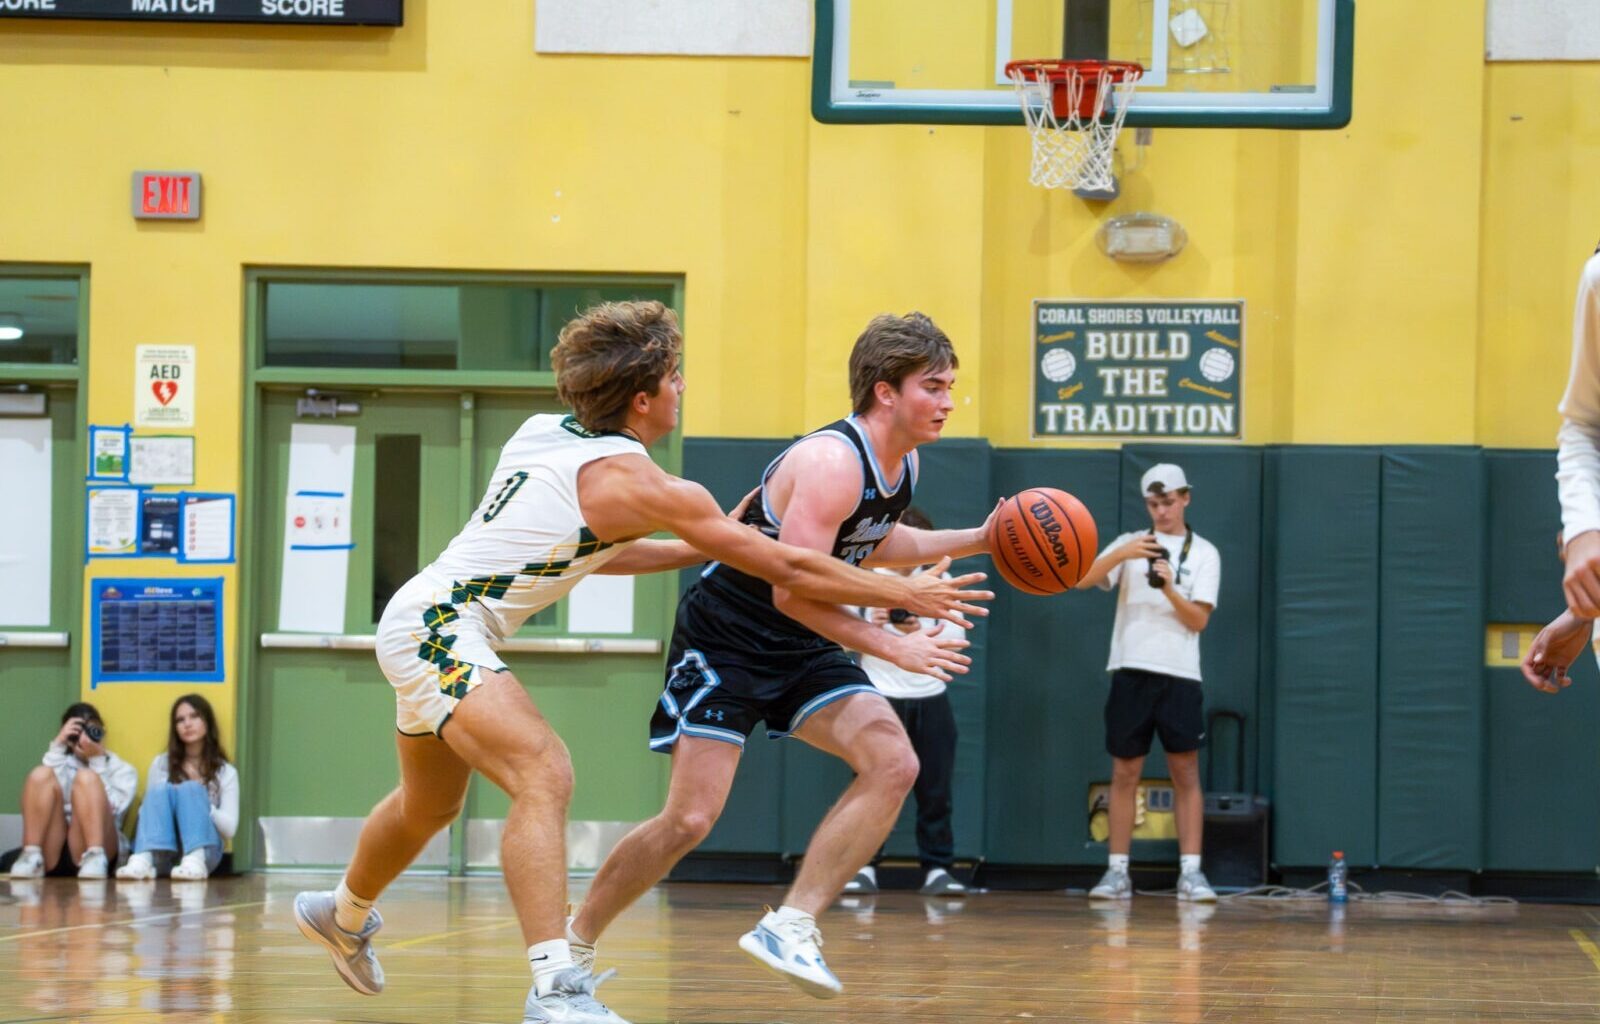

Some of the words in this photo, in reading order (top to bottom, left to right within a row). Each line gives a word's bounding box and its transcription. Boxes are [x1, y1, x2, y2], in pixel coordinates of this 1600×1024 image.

[131, 0, 215, 13] MATCH
[261, 0, 344, 17] SCORE
[143, 175, 192, 214] EXIT
[1038, 308, 1085, 324] CORAL
[1088, 308, 1143, 324] SHORES
[1146, 308, 1240, 324] VOLLEYBALL
[1085, 331, 1190, 360] BUILD
[150, 364, 181, 379] AED
[1098, 367, 1168, 396] THE
[1040, 404, 1235, 433] TRADITION
[1030, 499, 1069, 568] Wilson
